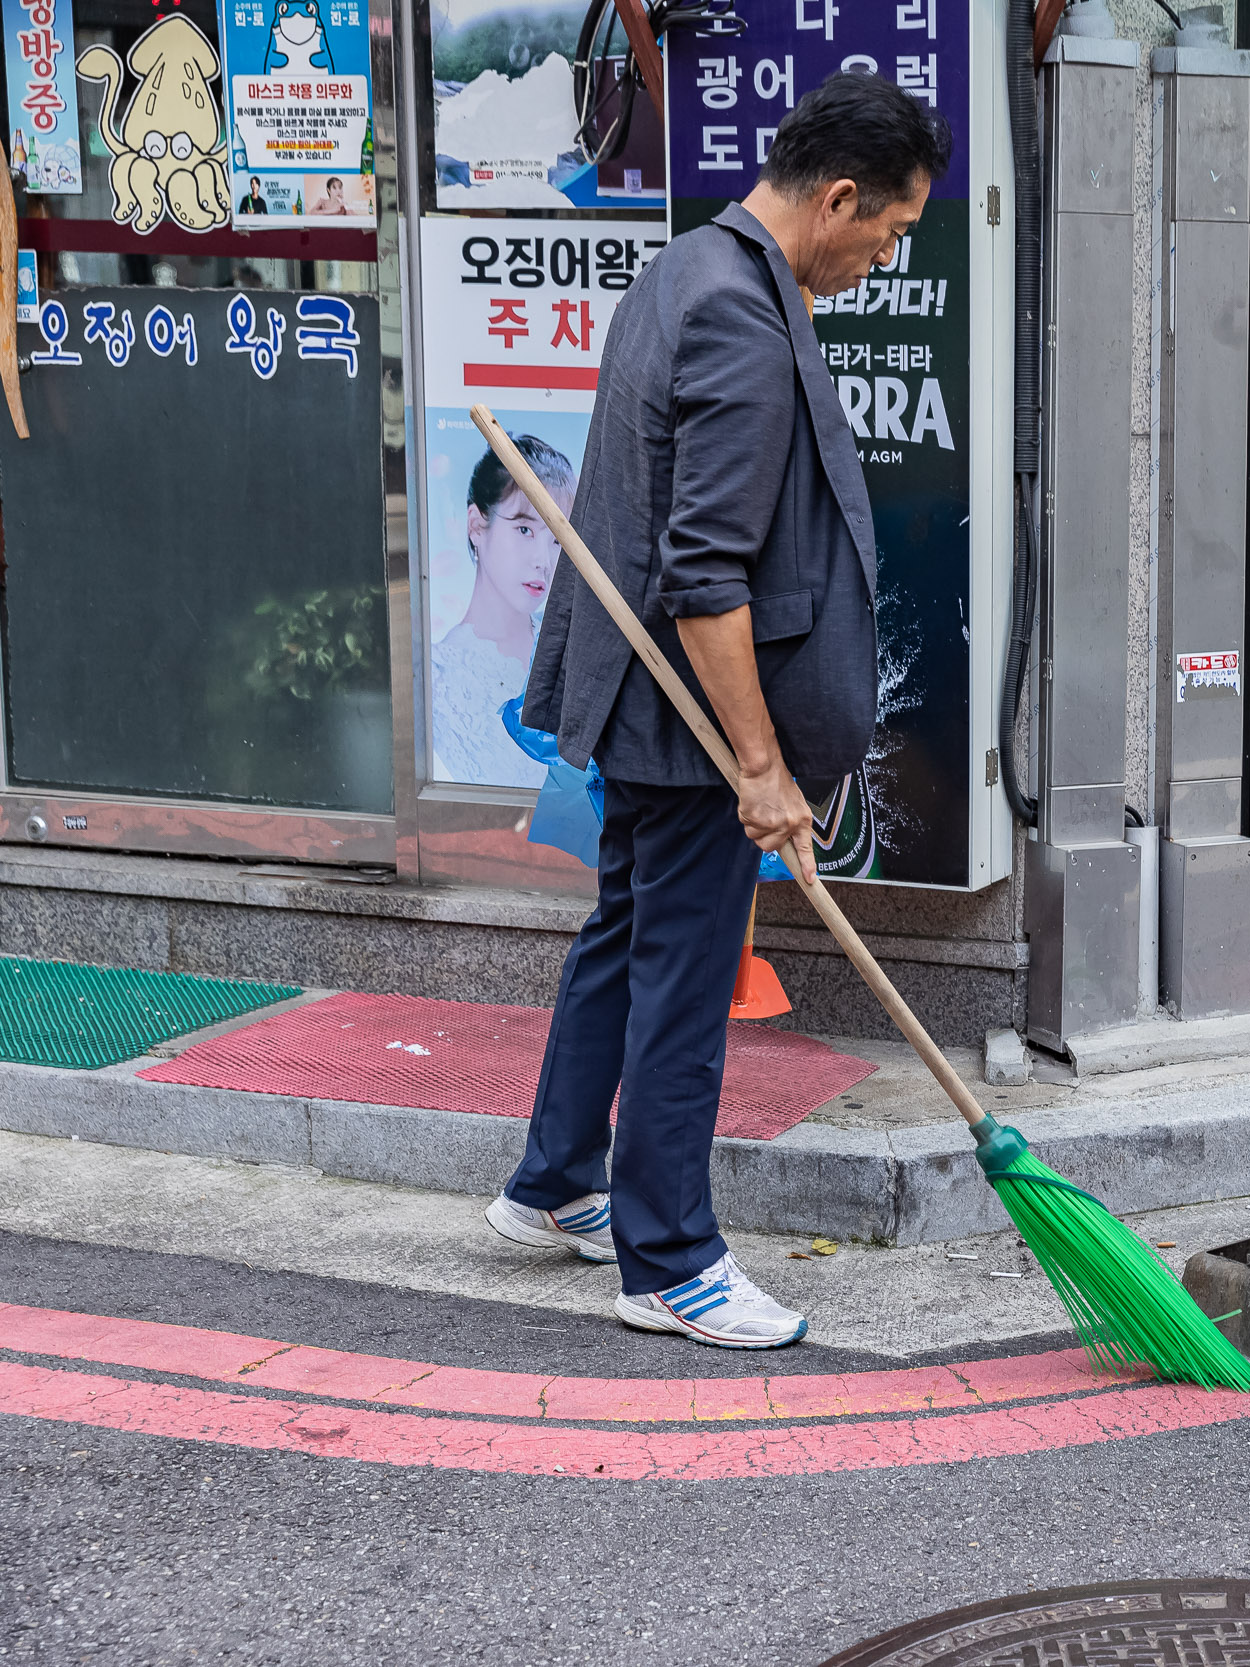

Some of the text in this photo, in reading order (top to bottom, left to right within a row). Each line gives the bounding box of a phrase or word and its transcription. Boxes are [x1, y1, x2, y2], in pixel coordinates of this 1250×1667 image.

[248, 83, 352, 99] 마스크 착용 의무화
[697, 55, 794, 109] 광어
[31, 293, 361, 379] 오징어 왕국
[832, 375, 956, 451] RRA
[869, 450, 903, 464] AGM
[818, 860, 839, 872] BEER
[839, 849, 857, 868] MADE
